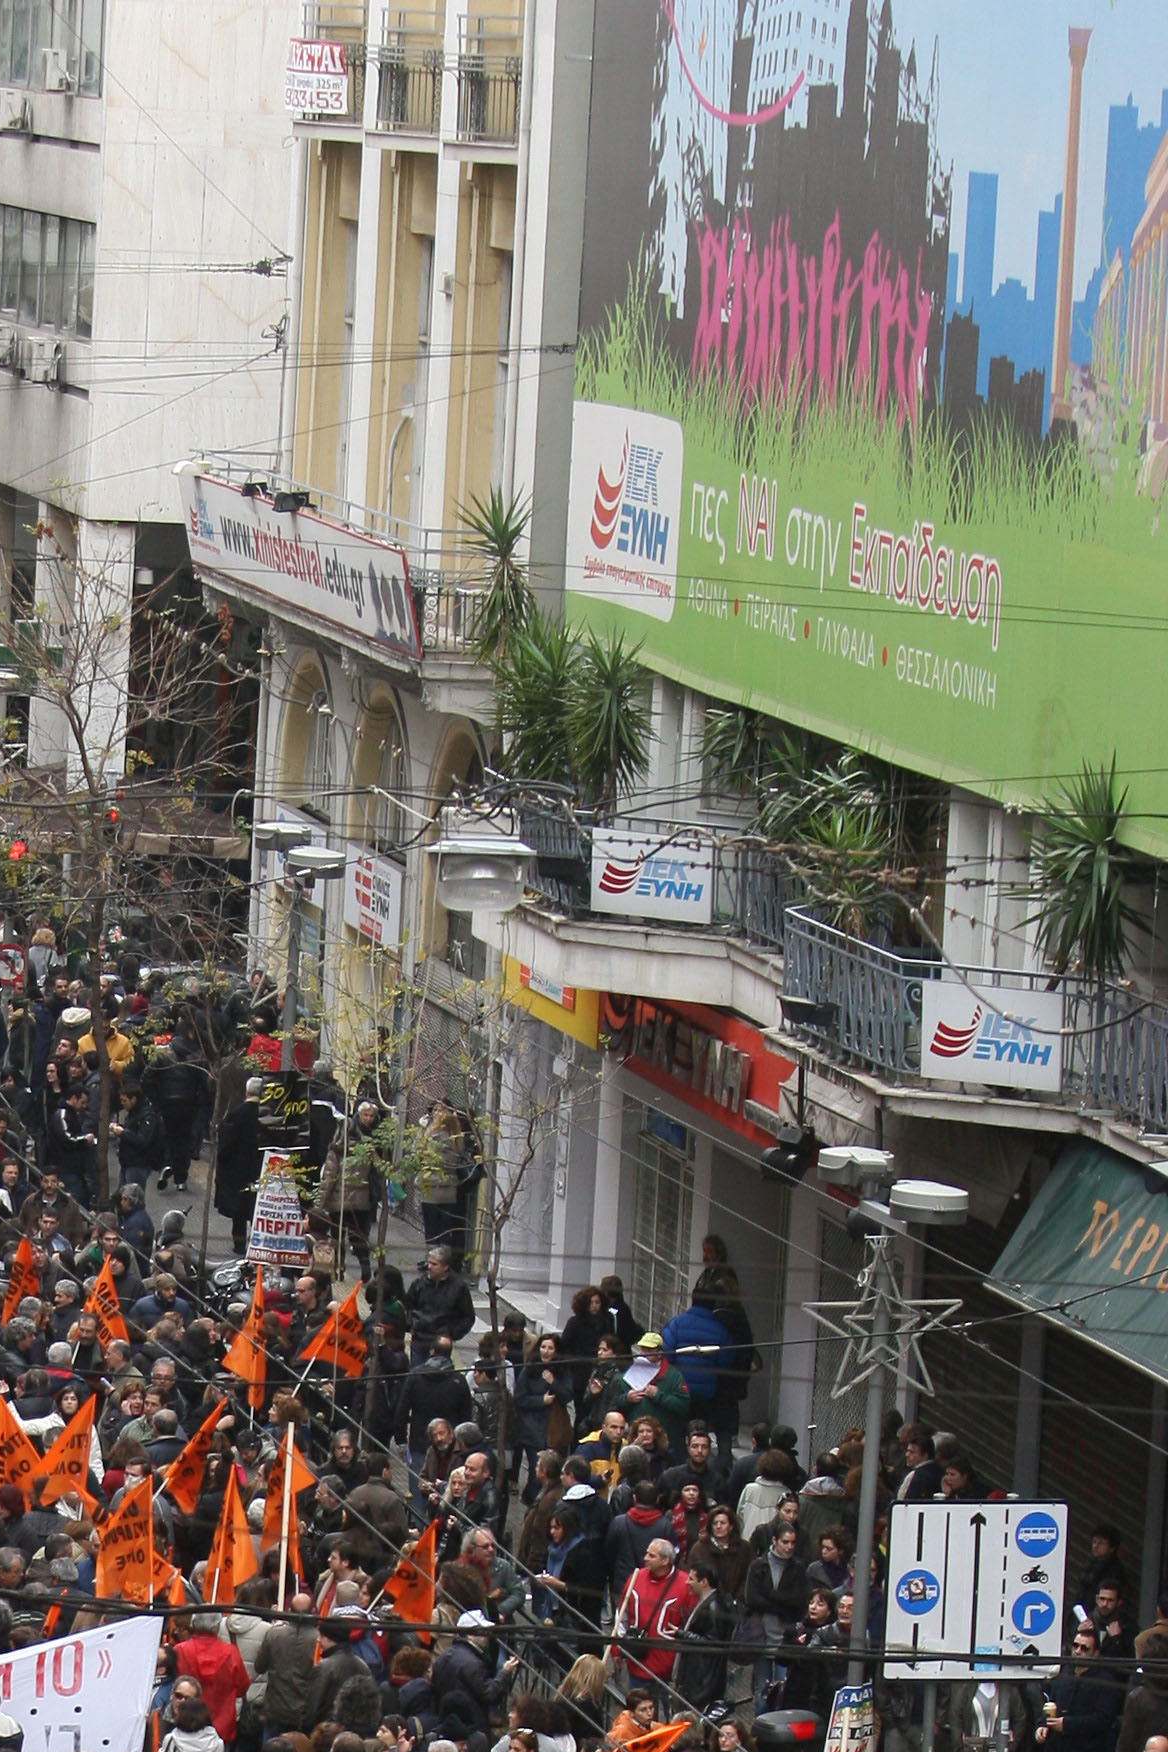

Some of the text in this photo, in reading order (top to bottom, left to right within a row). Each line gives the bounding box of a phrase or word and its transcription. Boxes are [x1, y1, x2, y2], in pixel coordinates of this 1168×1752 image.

[625, 443, 664, 507] ΙΕΚ
[617, 503, 670, 566] ΞΥΝΗ
[690, 473, 1002, 652] πες ΝΑΙ στην Εκπαίδευση
[220, 515, 366, 619] www.xinisfestival.edu.gr
[687, 576, 998, 709] ΑΘΗΝΑ ΠΕΙΡΑΙΑΣ ΓΛΥΦΑΔΑ ΘΕΣΣΑΛΟΝΙΚΗ
[635, 879, 704, 902] ΞΥΝΗ
[972, 1040, 1052, 1067] ΞΥΝΗ
[982, 1014, 1038, 1042] ΙΕΚ
